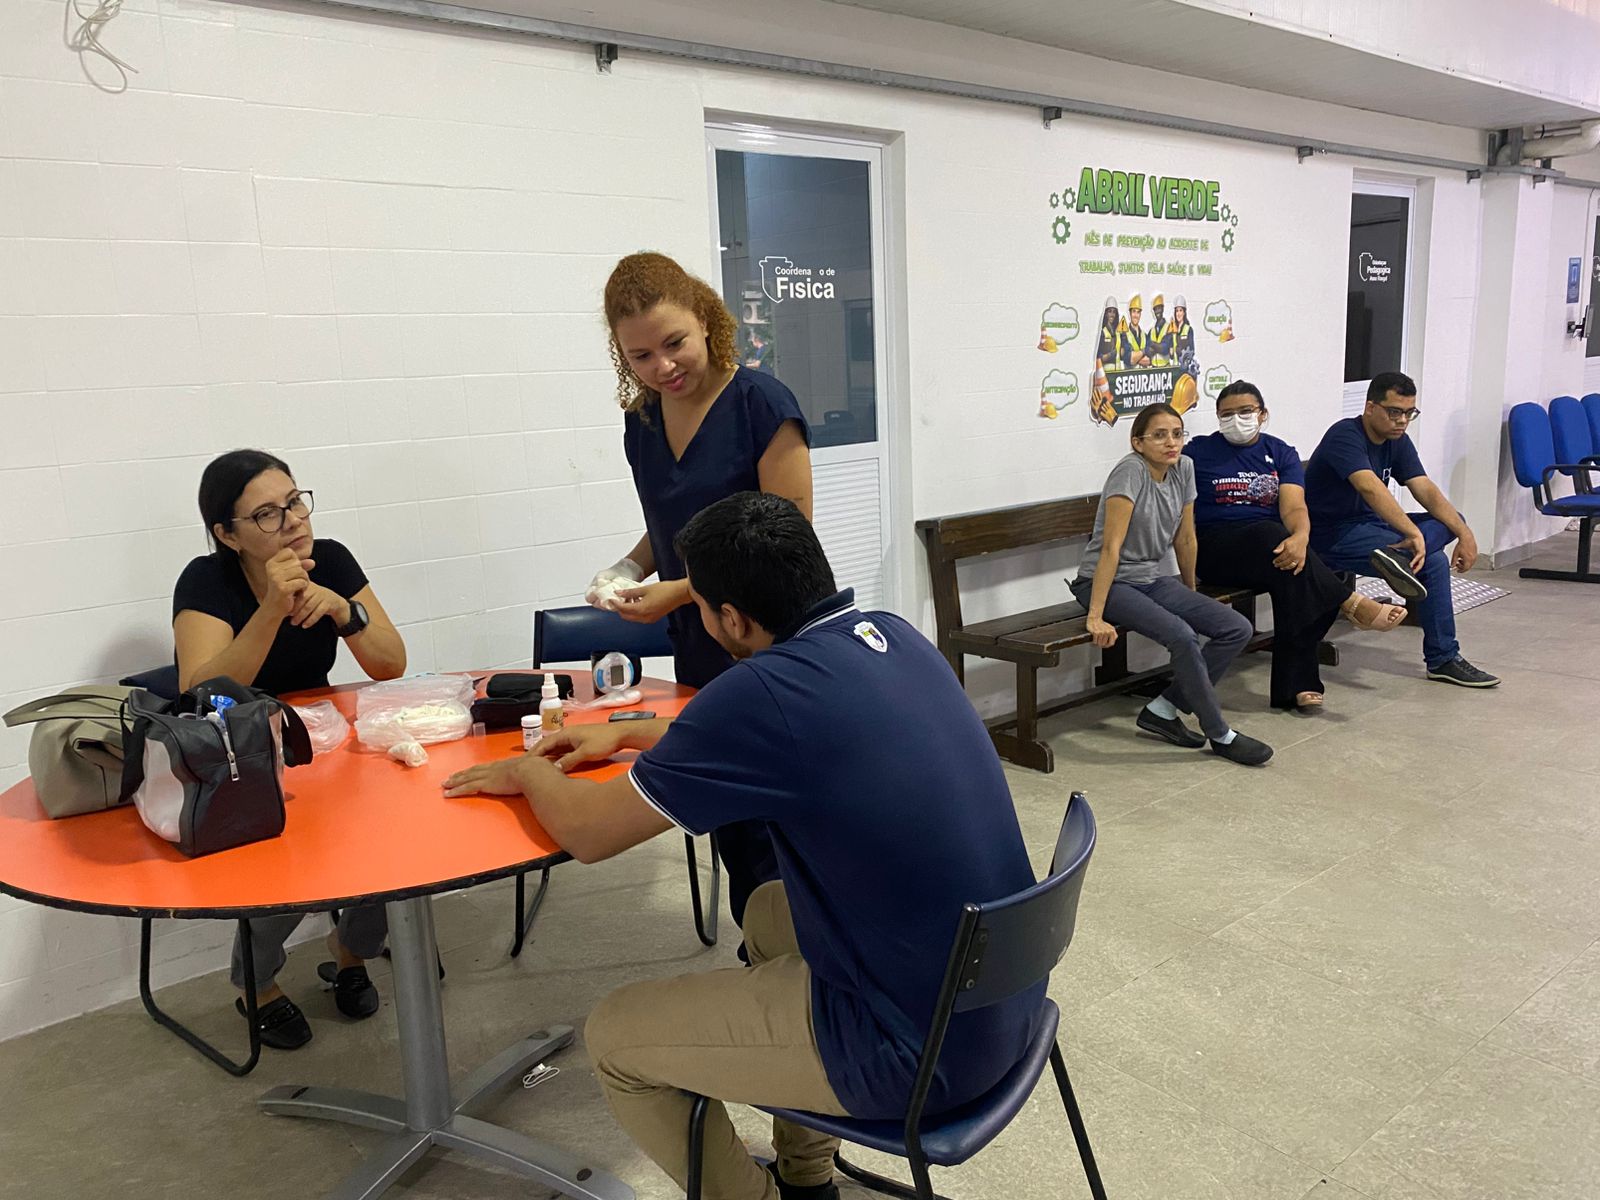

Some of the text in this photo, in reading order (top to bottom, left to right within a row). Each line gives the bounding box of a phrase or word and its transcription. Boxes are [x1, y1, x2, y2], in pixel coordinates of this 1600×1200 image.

[1076, 167, 1220, 222] ABRIL VERDE
[1102, 232, 1113, 247] DE
[825, 267, 836, 276] de
[1117, 261, 1145, 275] JUNTOS
[1114, 371, 1173, 396] SEGURANÇA
[1123, 393, 1166, 409] NO TRABALHO
